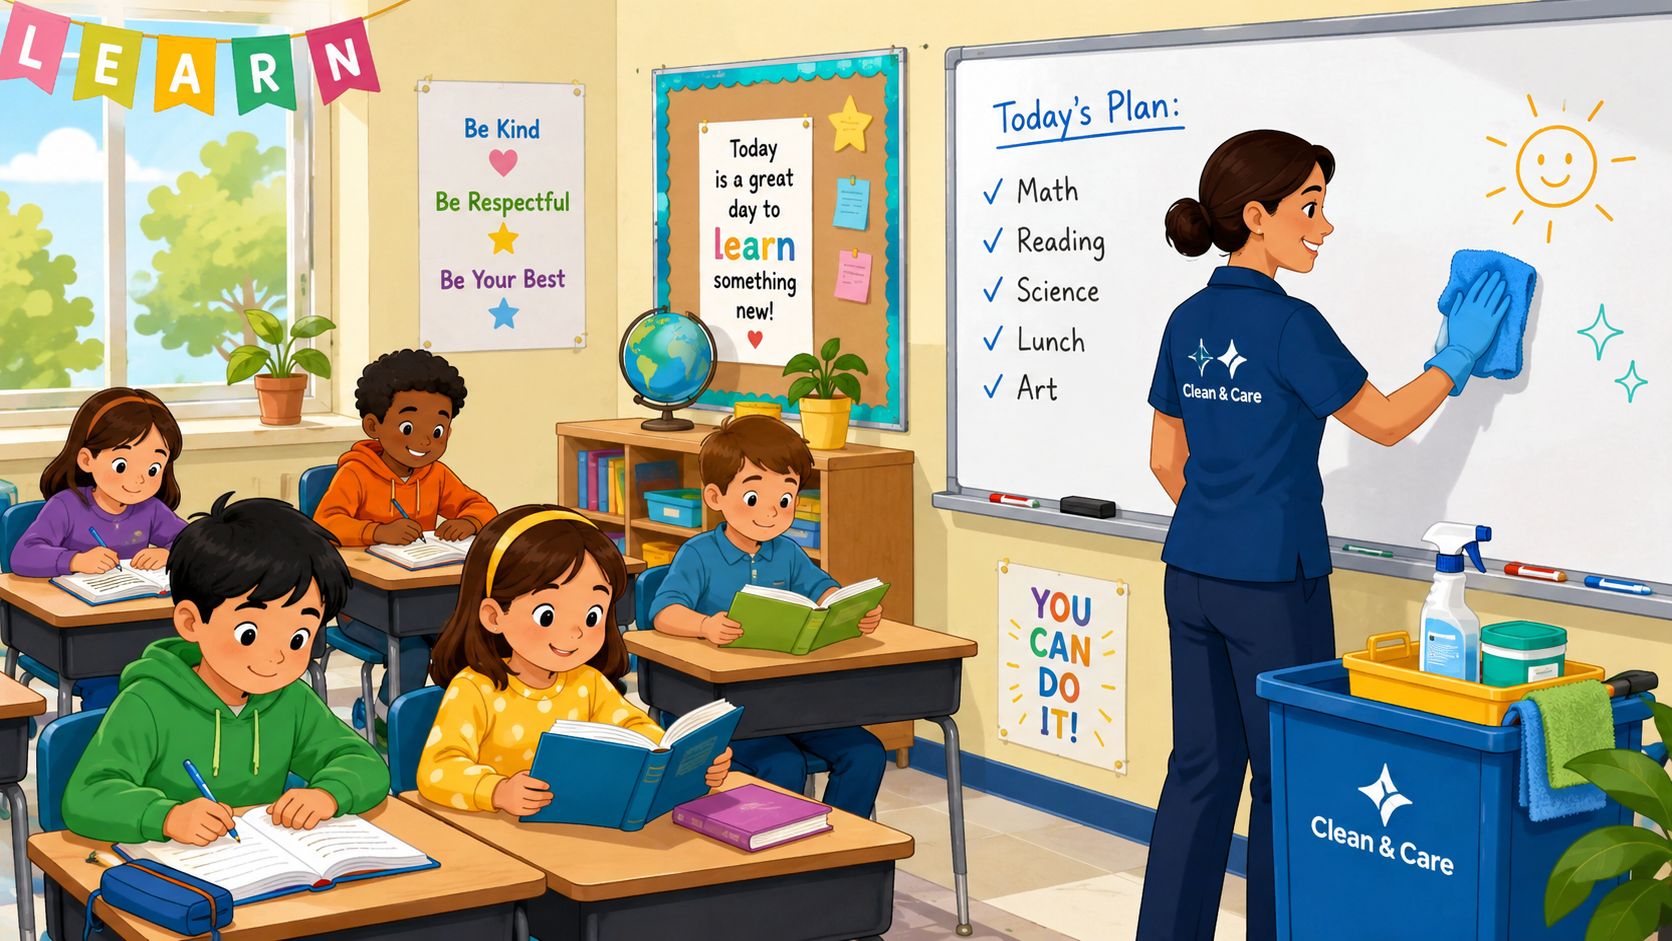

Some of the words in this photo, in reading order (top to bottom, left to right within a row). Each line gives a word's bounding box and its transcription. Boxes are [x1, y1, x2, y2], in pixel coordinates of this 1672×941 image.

[18, 24, 362, 94] LEARN
[464, 118, 489, 139] Be
[497, 118, 540, 140] Kind
[993, 96, 1092, 142] Today's
[1107, 89, 1179, 123] Plan:
[729, 137, 778, 163] Today
[715, 170, 728, 189] is
[733, 175, 744, 189] a
[749, 168, 795, 194] great
[1017, 175, 1079, 204] Math
[435, 191, 461, 212] Be
[468, 190, 570, 217] Respectful
[728, 198, 758, 224] day
[762, 200, 781, 219] to
[714, 226, 796, 262] learn
[1017, 226, 1105, 262] Reading
[440, 269, 465, 290] Be
[471, 269, 517, 290] Your
[523, 268, 566, 289] Best
[713, 270, 797, 298] something
[1017, 276, 1100, 302] Science
[736, 301, 774, 321] new!
[1018, 326, 1085, 353] Lunch
[1017, 374, 1058, 401] Art
[1183, 383, 1216, 400] Clean
[1219, 386, 1228, 401] &
[1230, 387, 1262, 404] Care
[1031, 587, 1092, 626] YOU
[1029, 626, 1091, 668] CAN
[1039, 665, 1081, 704] DO
[1040, 705, 1078, 744] IT!
[1311, 815, 1374, 852] Clean
[1379, 837, 1395, 859] &
[1400, 842, 1454, 876] Care
